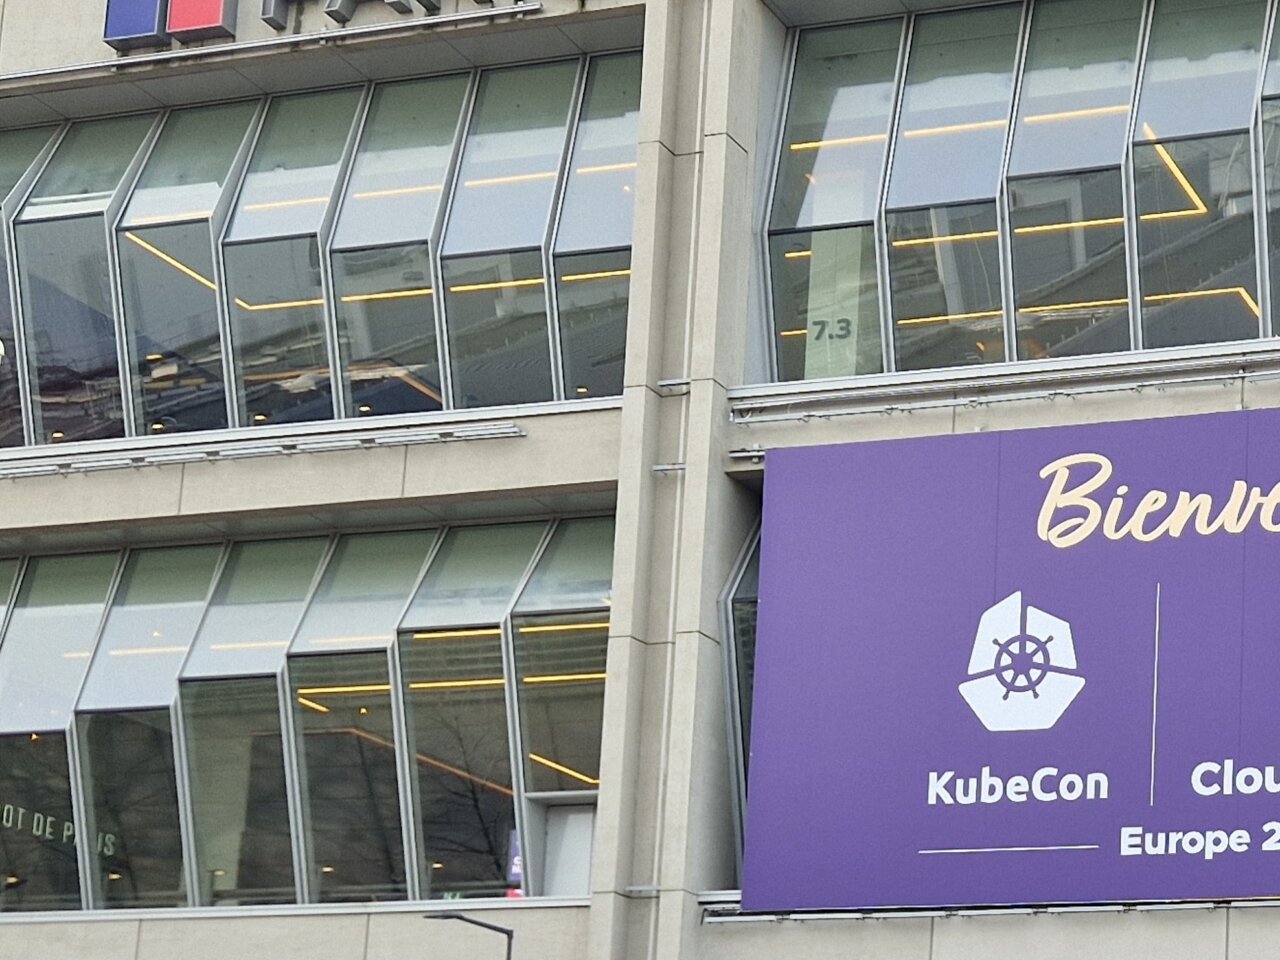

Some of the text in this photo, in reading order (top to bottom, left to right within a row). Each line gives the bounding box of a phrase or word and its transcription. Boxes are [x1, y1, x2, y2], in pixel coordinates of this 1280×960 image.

[812, 318, 852, 341] 7.3
[927, 766, 1109, 806] KubeCon
[32, 812, 57, 840] DE
[63, 821, 116, 856] PIS
[1120, 826, 1251, 860] Europe
